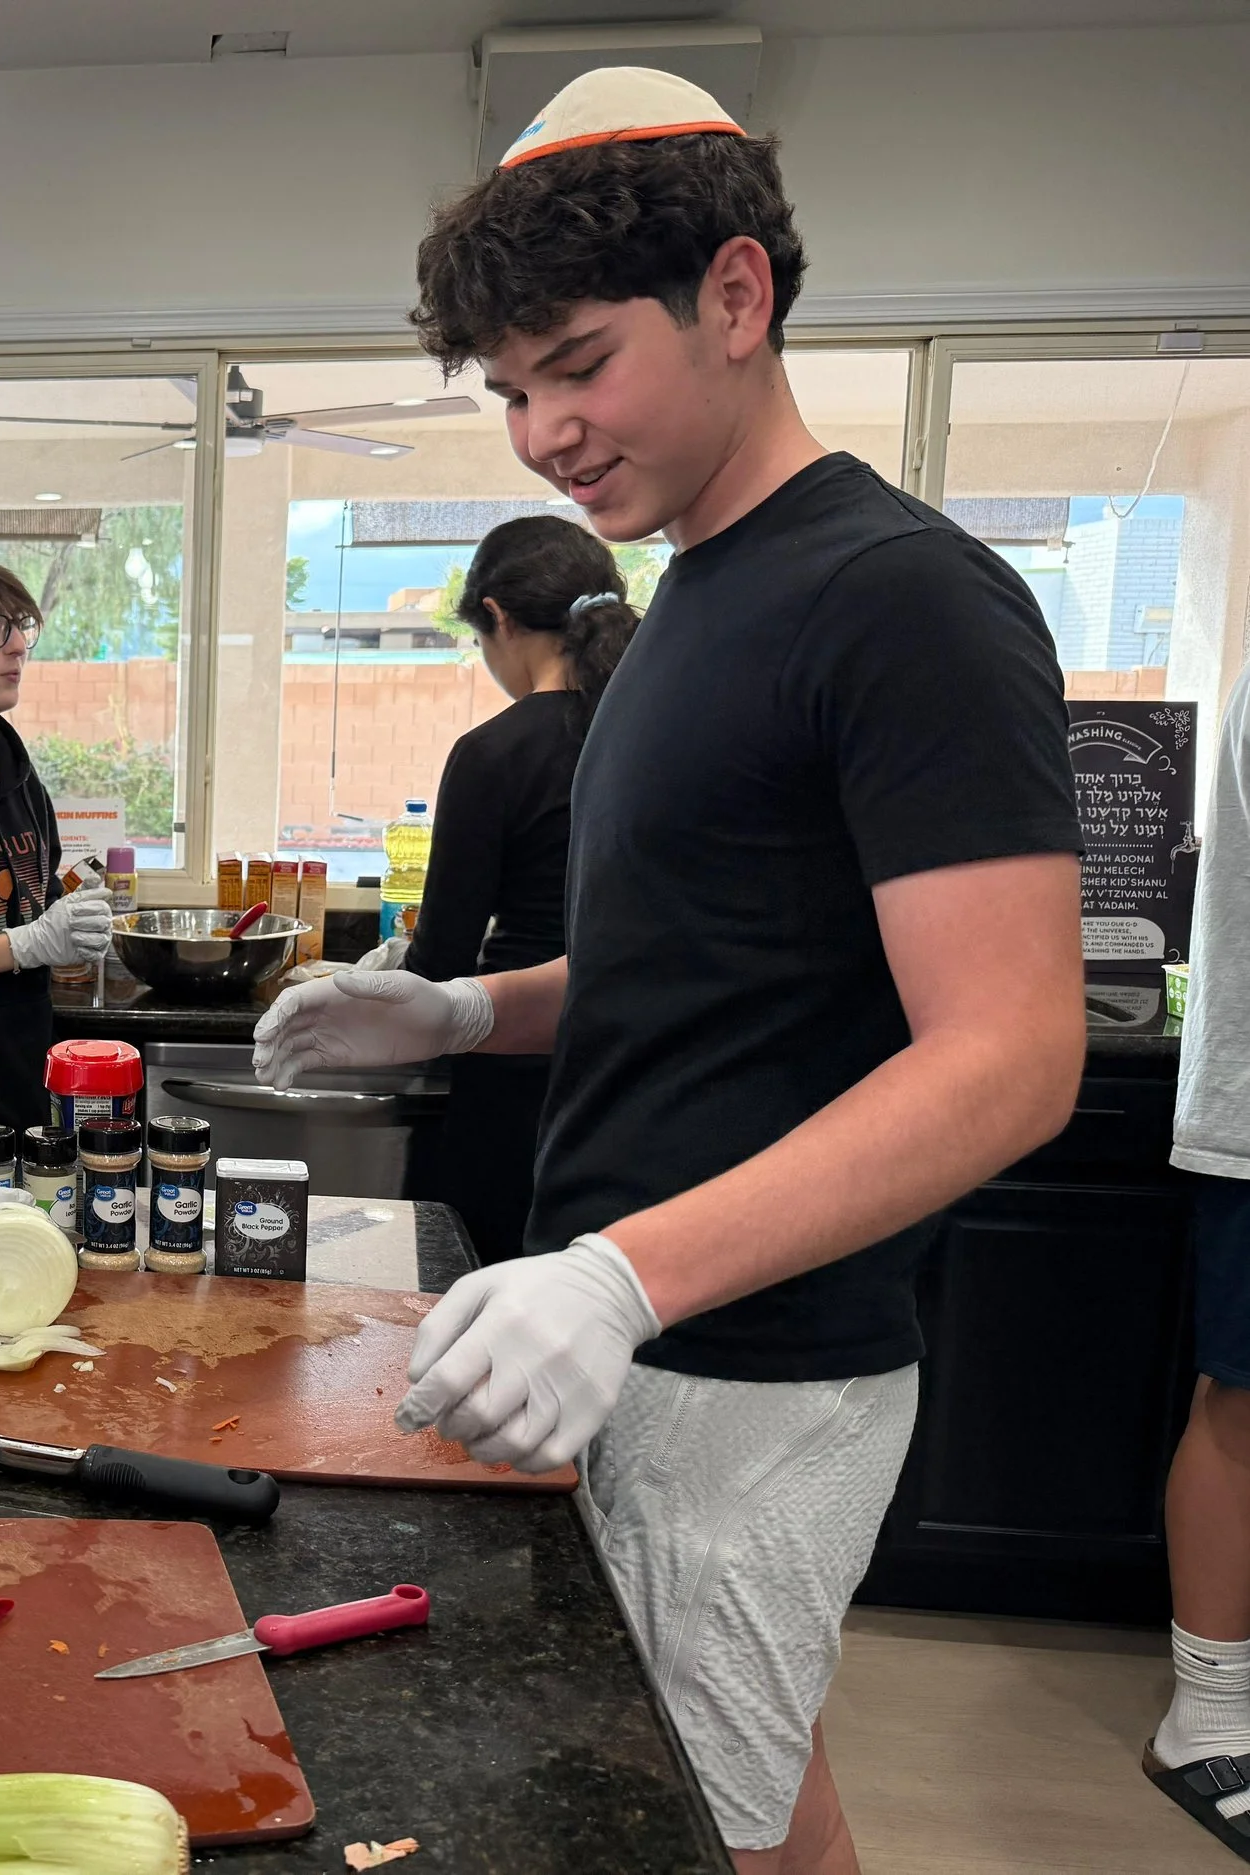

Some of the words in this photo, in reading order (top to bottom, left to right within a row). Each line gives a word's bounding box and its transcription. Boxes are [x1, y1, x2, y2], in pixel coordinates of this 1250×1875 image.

[75, 811, 118, 820] MUFFINS
[11, 831, 47, 855] UT
[1086, 854, 1110, 862] ATAH
[1114, 854, 1154, 863] ADONAI
[1103, 866, 1145, 875] MELECH
[1081, 877, 1107, 886] SHER
[1110, 878, 1167, 887] KID'SHANU
[1096, 889, 1153, 899] V'TZIVANU
[1155, 891, 1168, 899] AL
[1098, 901, 1139, 910] YADAIM.
[111, 1200, 132, 1210] Garlic
[175, 1200, 198, 1209] Garlic
[110, 1208, 132, 1217] Powder
[174, 1208, 198, 1216] Powder
[259, 1217, 284, 1225] Ground
